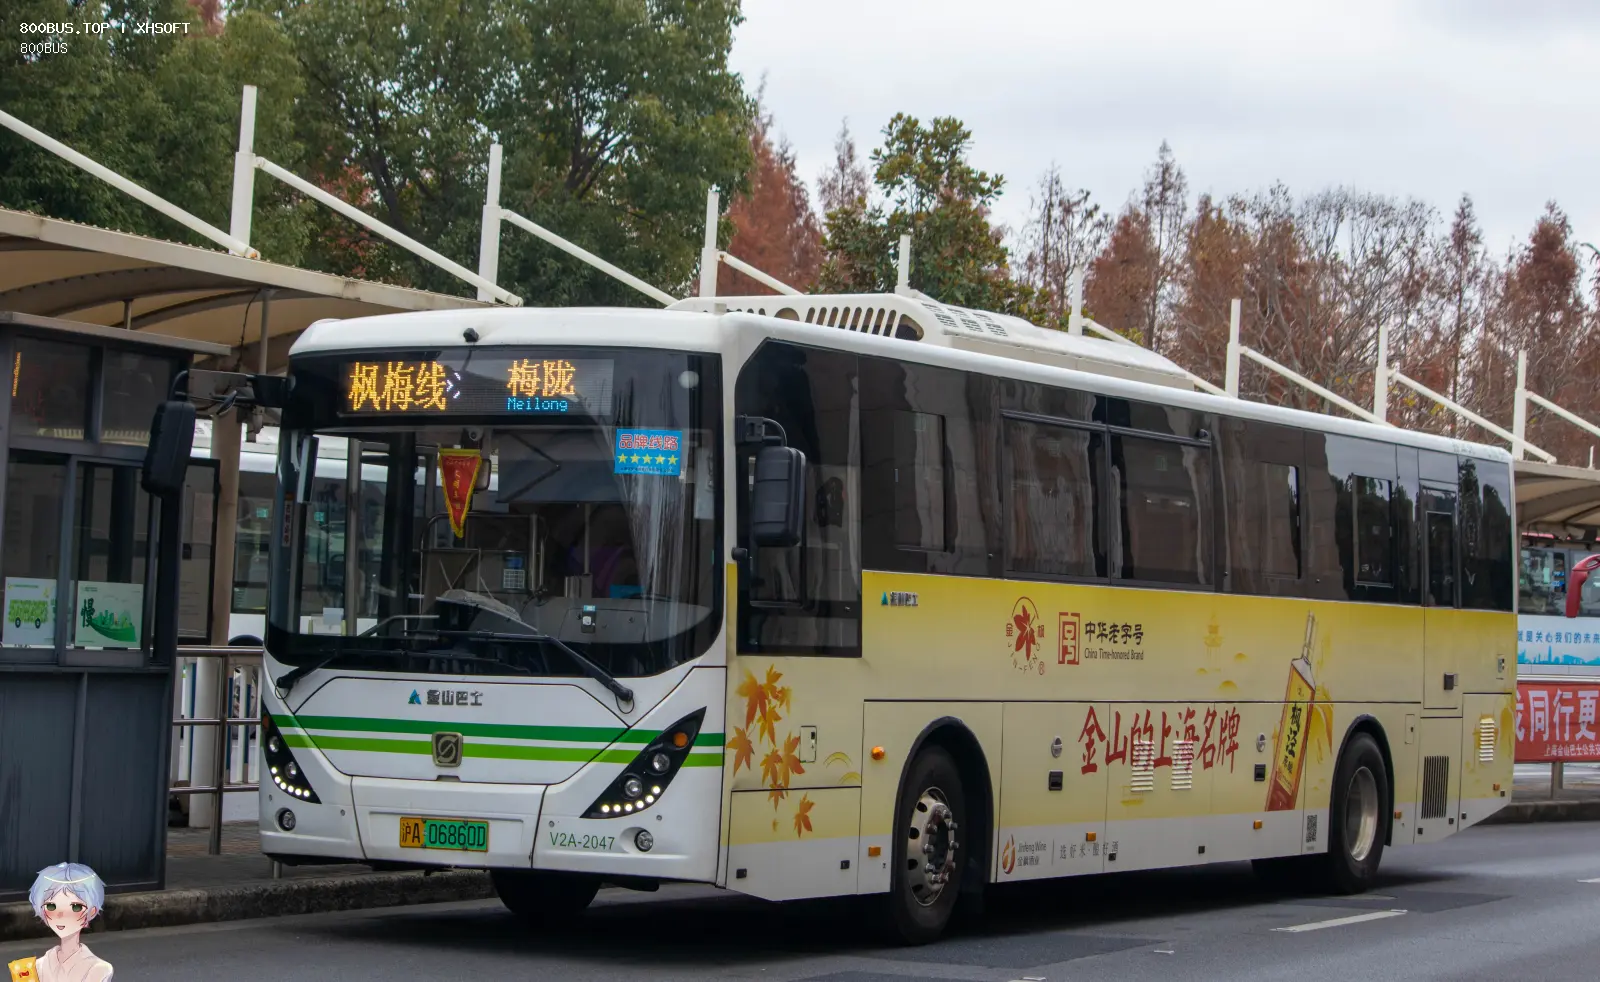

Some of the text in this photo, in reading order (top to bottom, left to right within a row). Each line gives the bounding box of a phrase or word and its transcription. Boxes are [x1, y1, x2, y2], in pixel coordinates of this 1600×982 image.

[348, 359, 577, 411] 枫梅线 梅陇
[507, 397, 568, 412] Meilong
[619, 433, 679, 451] 品牌线路
[1084, 621, 1144, 646] 中华老字号
[1084, 647, 1144, 661] China Time-honored Brand
[1078, 705, 1241, 776] 金山的上海名牌
[550, 832, 615, 850] V2A-2047
